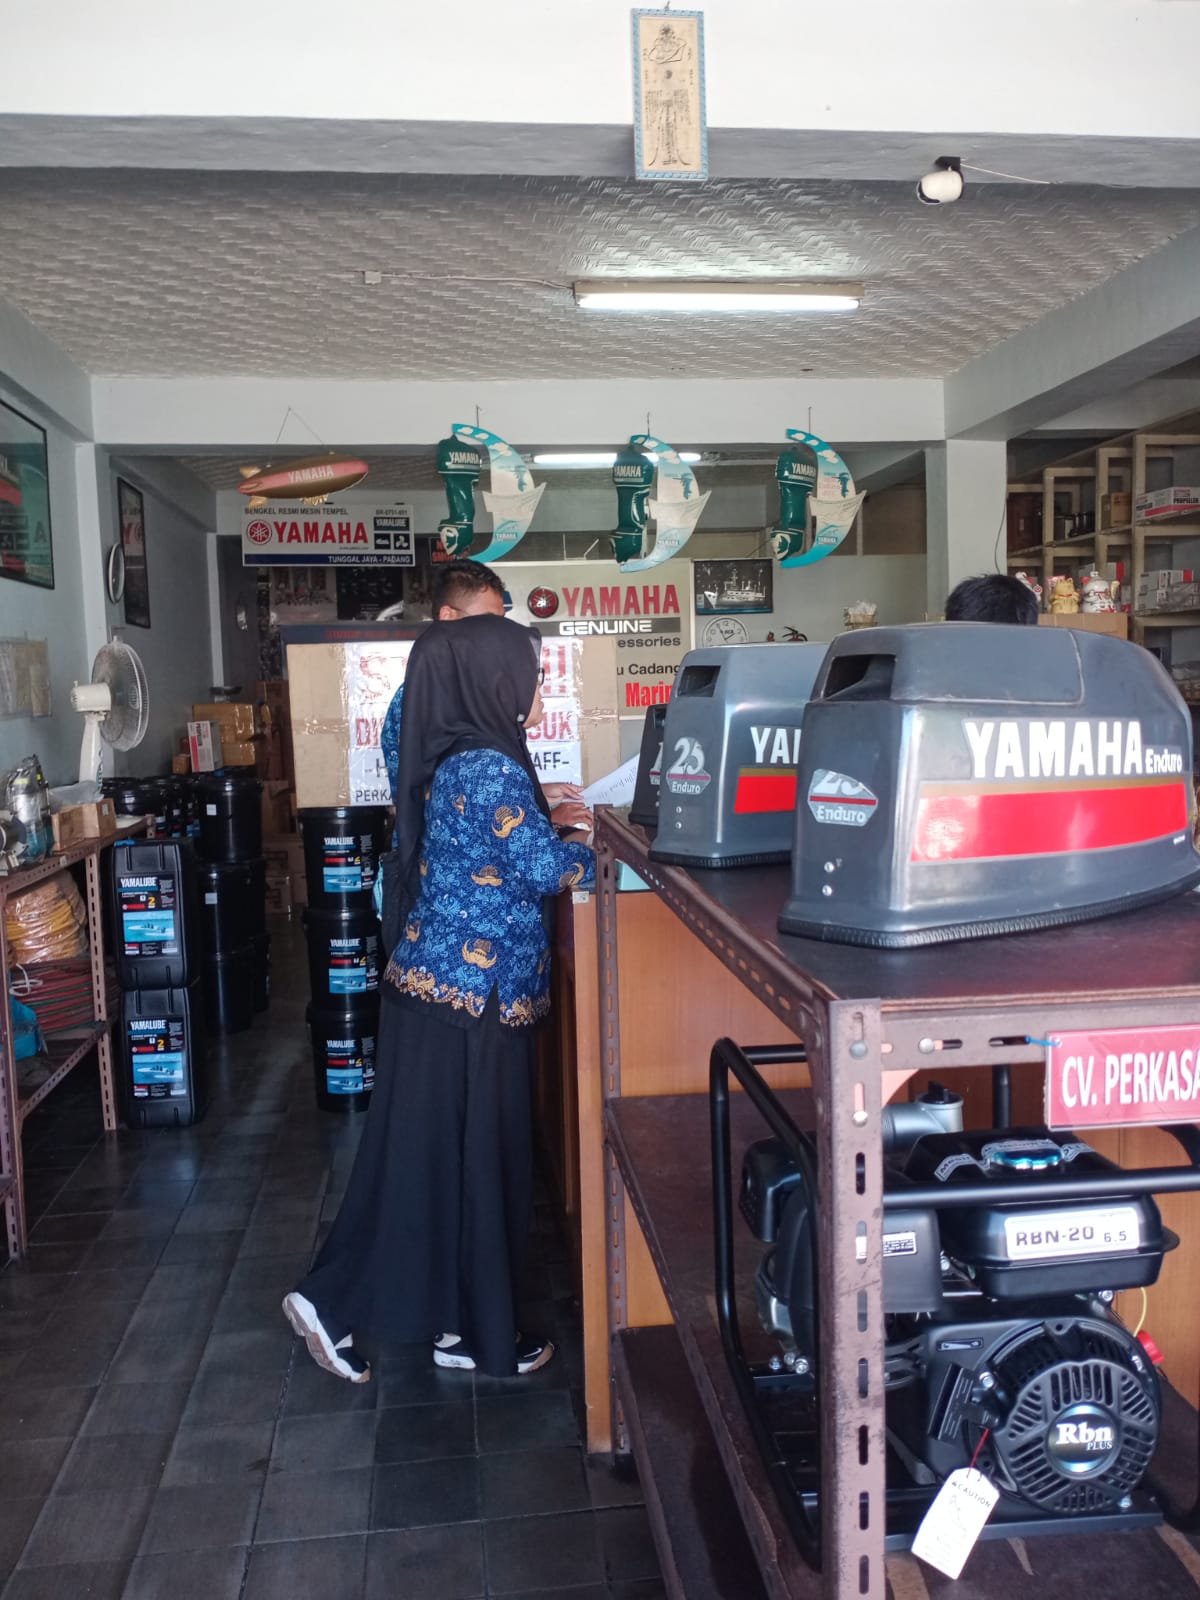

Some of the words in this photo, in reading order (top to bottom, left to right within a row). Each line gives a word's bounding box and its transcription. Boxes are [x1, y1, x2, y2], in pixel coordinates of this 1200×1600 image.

[449, 452, 480, 465] YAMAHA
[287, 465, 334, 483] YAMAHA
[791, 462, 816, 478] YAMAHA
[244, 508, 277, 516] BENGKEL
[278, 508, 299, 516] RESMI
[301, 508, 321, 516] MESIN
[322, 508, 348, 516] TEMPEL
[273, 521, 369, 545] YAMAHA
[328, 555, 360, 564] TUNGGAL
[361, 556, 378, 564] JAYA
[383, 556, 411, 564] PADANG
[562, 584, 681, 617] YAMAHA
[559, 619, 653, 636] GENUINE
[617, 636, 681, 648] essories
[670, 737, 705, 775] 25
[964, 720, 1143, 779] YAMAHA
[1145, 748, 1183, 774] Enduro
[672, 780, 701, 794] Enduro
[816, 805, 866, 823] Enduro
[324, 837, 355, 846] YAMALUBE
[120, 877, 157, 888] YAMALUBE
[148, 896, 156, 905] 2
[330, 939, 360, 948] YAMALUBE
[130, 1020, 167, 1031] YAMALUBE
[157, 1039, 165, 1048] 2
[326, 1040, 356, 1049] YAMALUBE
[1062, 1055, 1098, 1108] CV.
[1016, 1226, 1094, 1247] RBN-20
[1103, 1230, 1127, 1243] 6.5
[1056, 1422, 1113, 1445] Rbn
[1086, 1440, 1113, 1451] PLUS
[957, 1483, 991, 1508] CAUTION
